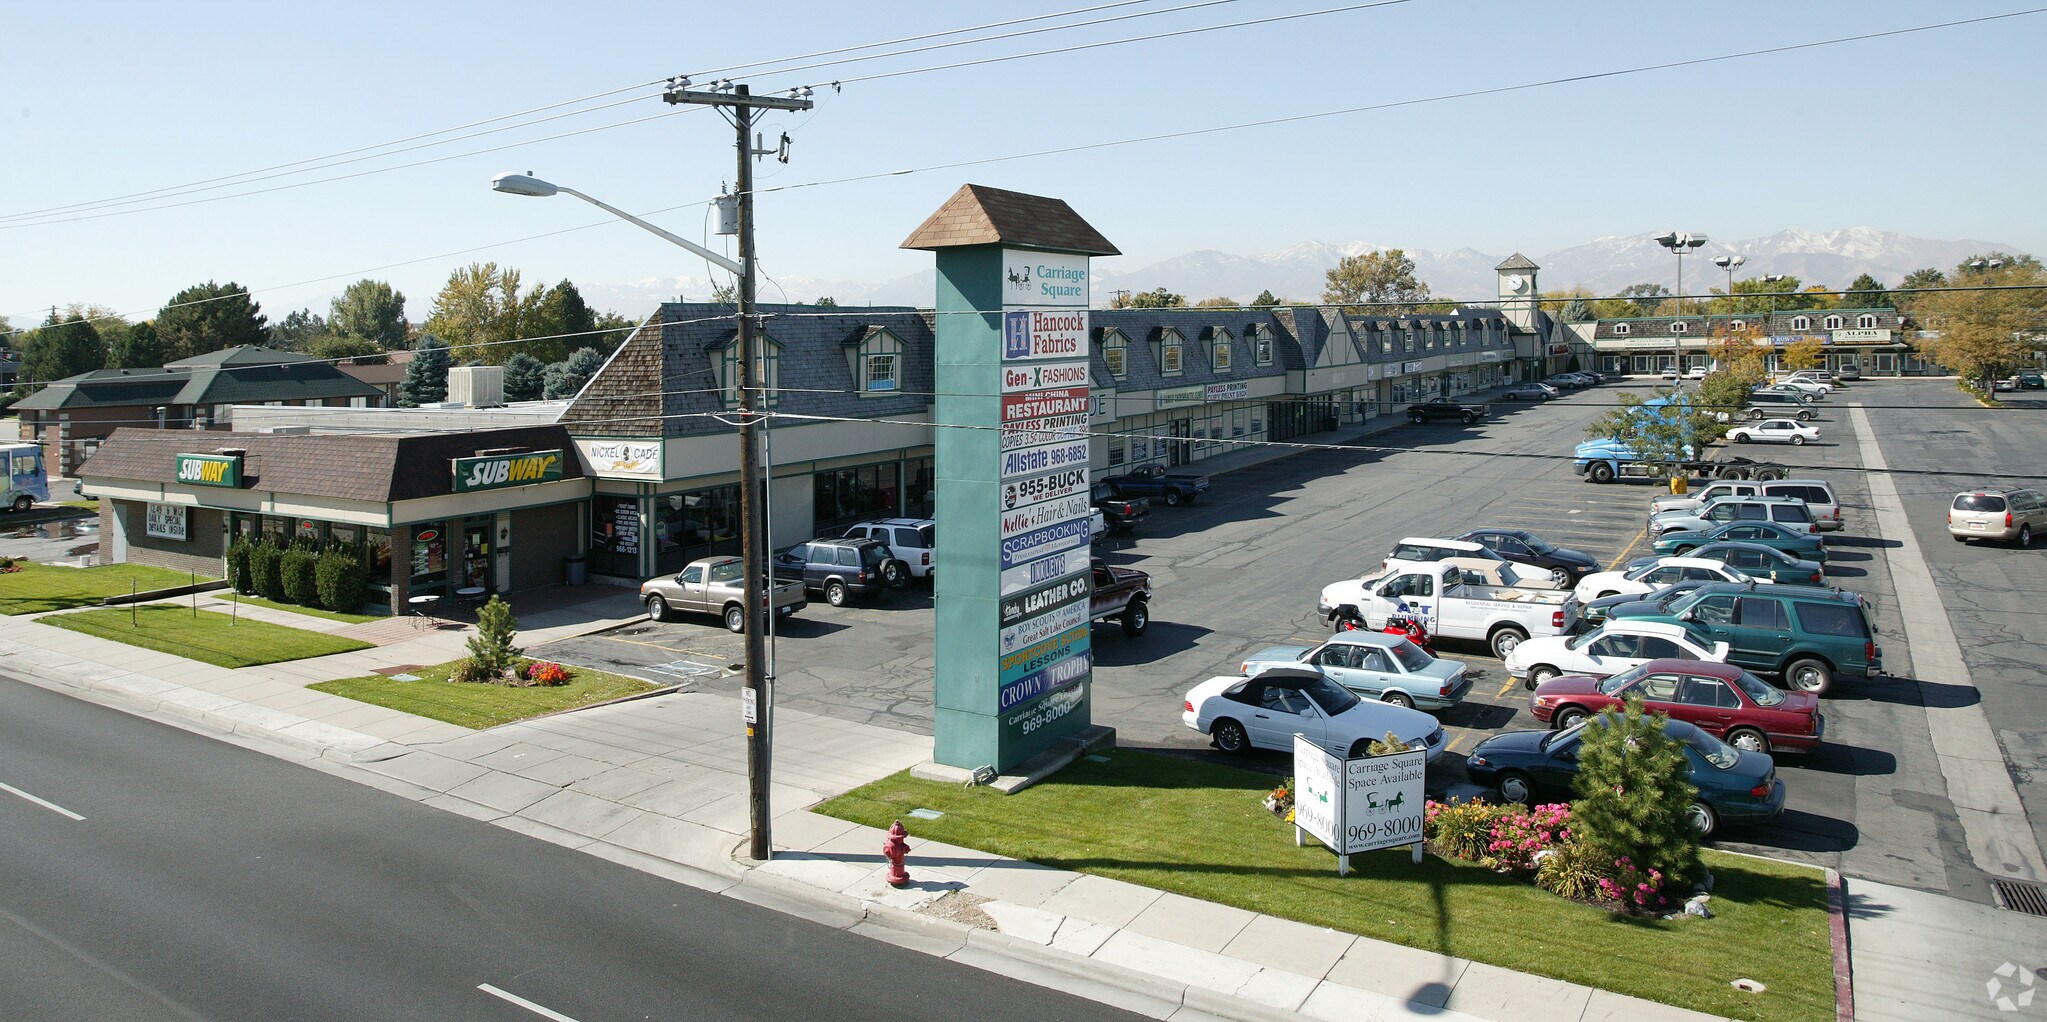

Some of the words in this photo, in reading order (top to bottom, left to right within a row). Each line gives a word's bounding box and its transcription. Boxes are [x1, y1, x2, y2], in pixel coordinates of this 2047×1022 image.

[1036, 265, 1085, 283] Carriage
[1041, 282, 1081, 299] Square
[1033, 312, 1084, 332] Hancock
[1033, 334, 1076, 354] Fabrics
[1042, 366, 1085, 383] FASHIONS
[1025, 393, 1043, 401] MINI
[1045, 390, 1069, 399] CHINA
[1208, 384, 1226, 394] PAYLESS
[1227, 382, 1248, 392] PRINTING
[1221, 392, 1235, 400] PRINT
[1007, 398, 1086, 419] RESTAURANT
[1002, 419, 1040, 436] PAYLESS
[1044, 414, 1087, 429] PRINTING
[1002, 433, 1022, 448] COPIES
[591, 447, 618, 459] NICKEL
[634, 449, 658, 460] CADE
[1004, 449, 1048, 474] Allstate
[179, 459, 228, 482] SUBWAY
[465, 455, 557, 487] SUBWAY
[1033, 493, 1043, 502] WE
[1045, 487, 1072, 498] DELIVER
[149, 513, 160, 524] DAILY
[165, 516, 181, 525] SPECIAL
[1004, 507, 1035, 533] Nellie's
[1036, 507, 1056, 524] Hair
[1057, 503, 1065, 519] &
[1066, 497, 1087, 517] Nails
[149, 523, 166, 533] DETAILS
[169, 525, 184, 535] INSIDE
[1003, 520, 1088, 561] SCRAPBOOKING
[1014, 547, 1044, 561] Treasured
[1052, 537, 1079, 549] Memories
[1025, 584, 1068, 613] LEATHER
[1070, 578, 1087, 596] CO.
[1018, 622, 1031, 634] BOY
[1032, 613, 1055, 629] SCOUTS
[1062, 602, 1086, 617] AMERICA
[1023, 632, 1038, 644] Great
[1040, 626, 1049, 638] Salt
[1050, 623, 1062, 633] Lake
[1062, 614, 1081, 628] Council
[1061, 628, 1088, 646] SCUBA
[1024, 646, 1071, 673] LESSONS
[1002, 674, 1042, 707] CROWN
[1050, 654, 1089, 685] TROPHY
[1008, 708, 1037, 726] Carriage
[1038, 696, 1060, 712] Square
[1022, 701, 1070, 734] 969-8000
[1349, 762, 1389, 775] Carriage
[1392, 756, 1423, 770] Square
[1349, 778, 1377, 791] Space
[1380, 770, 1422, 784] Available
[1296, 800, 1340, 842] 969-8000
[1349, 815, 1420, 843] 969-8000
[1348, 834, 1420, 849] www.carriagesquare.com
